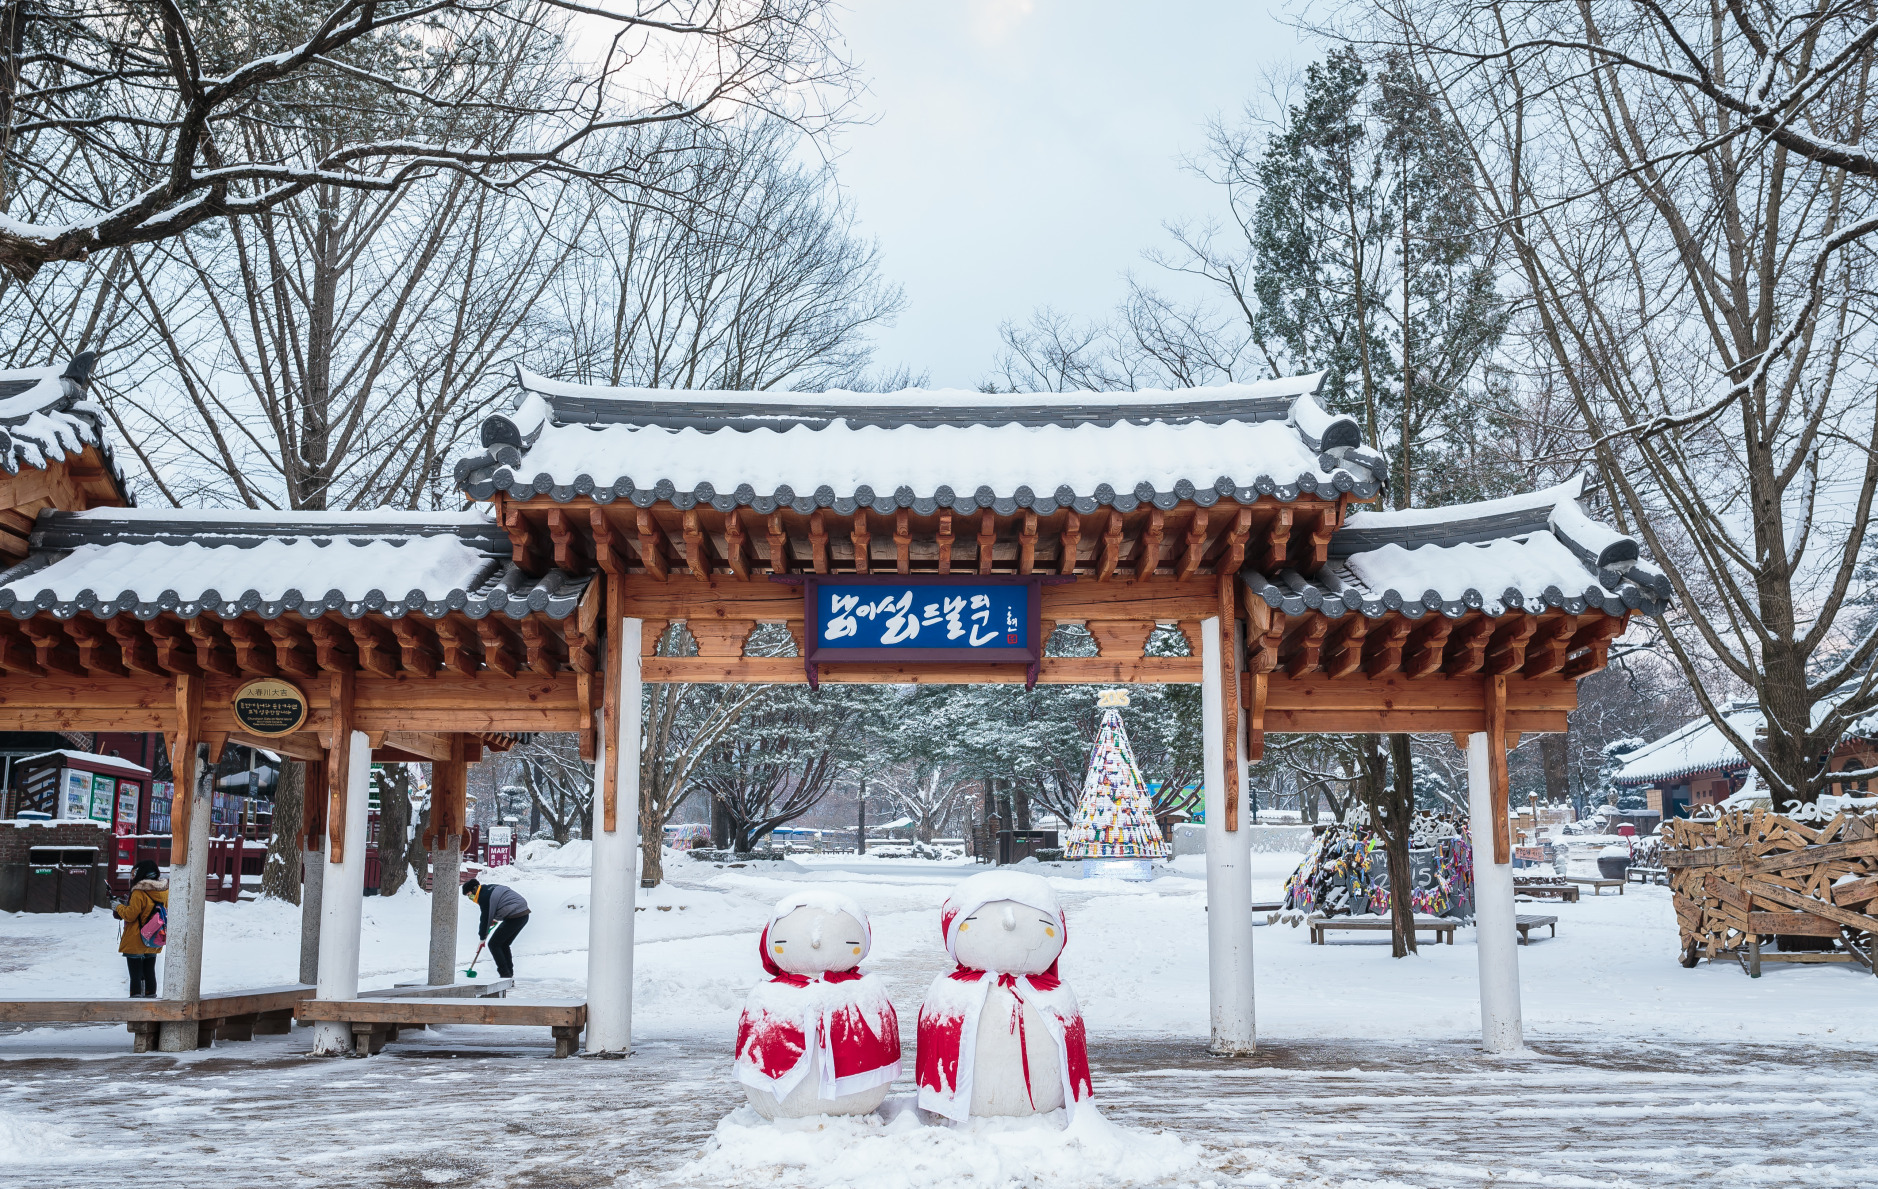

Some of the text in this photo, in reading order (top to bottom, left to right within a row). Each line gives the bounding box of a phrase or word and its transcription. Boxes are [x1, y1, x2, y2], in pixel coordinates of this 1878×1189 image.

[247, 689, 288, 697] 入春川大吉
[1097, 690, 1130, 706] 2015
[1782, 798, 1836, 822] 2015
